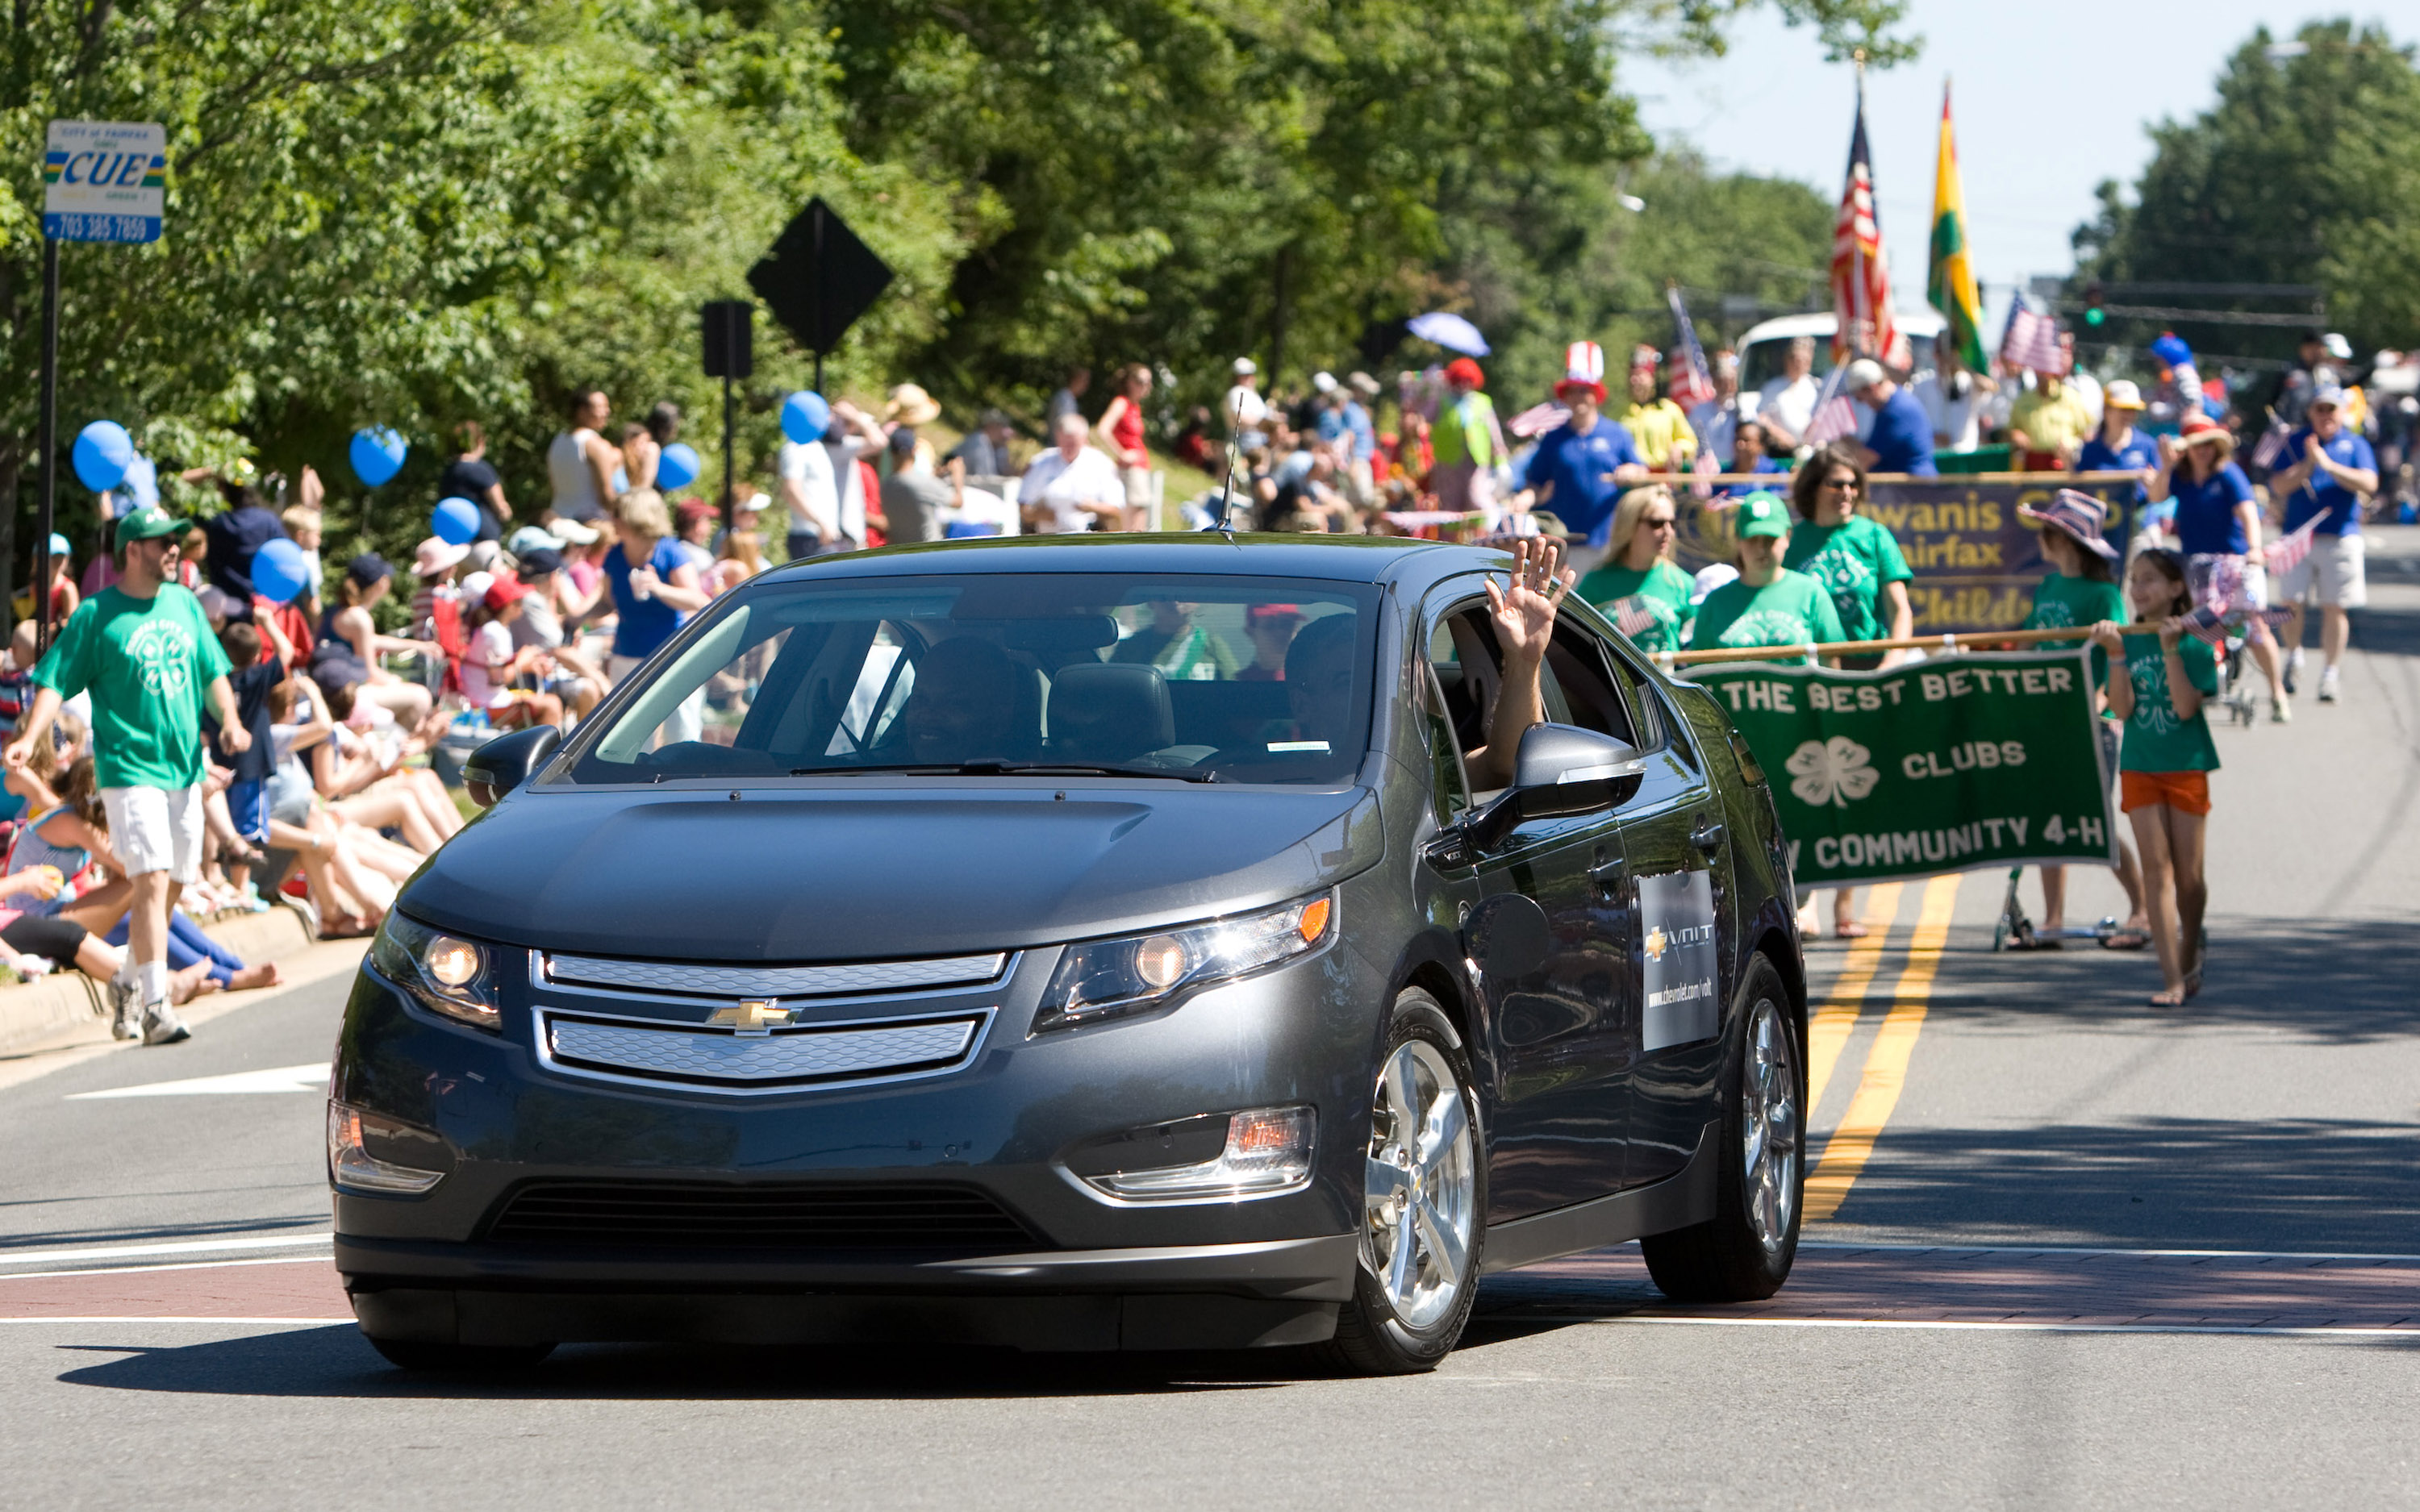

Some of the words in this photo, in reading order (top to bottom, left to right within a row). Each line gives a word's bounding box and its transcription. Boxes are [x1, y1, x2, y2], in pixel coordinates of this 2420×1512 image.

[65, 151, 147, 185] CUE
[60, 214, 83, 239] 703
[1721, 681, 1796, 714] THE
[1807, 679, 1907, 713] BEST
[1921, 668, 2073, 702] BETTER
[1901, 740, 2027, 780] CLUBS
[1815, 816, 2029, 869] COMMUNITY
[2043, 814, 2105, 847] 4-H
[1648, 977, 1712, 1008] www.chevrolet.com/volt
